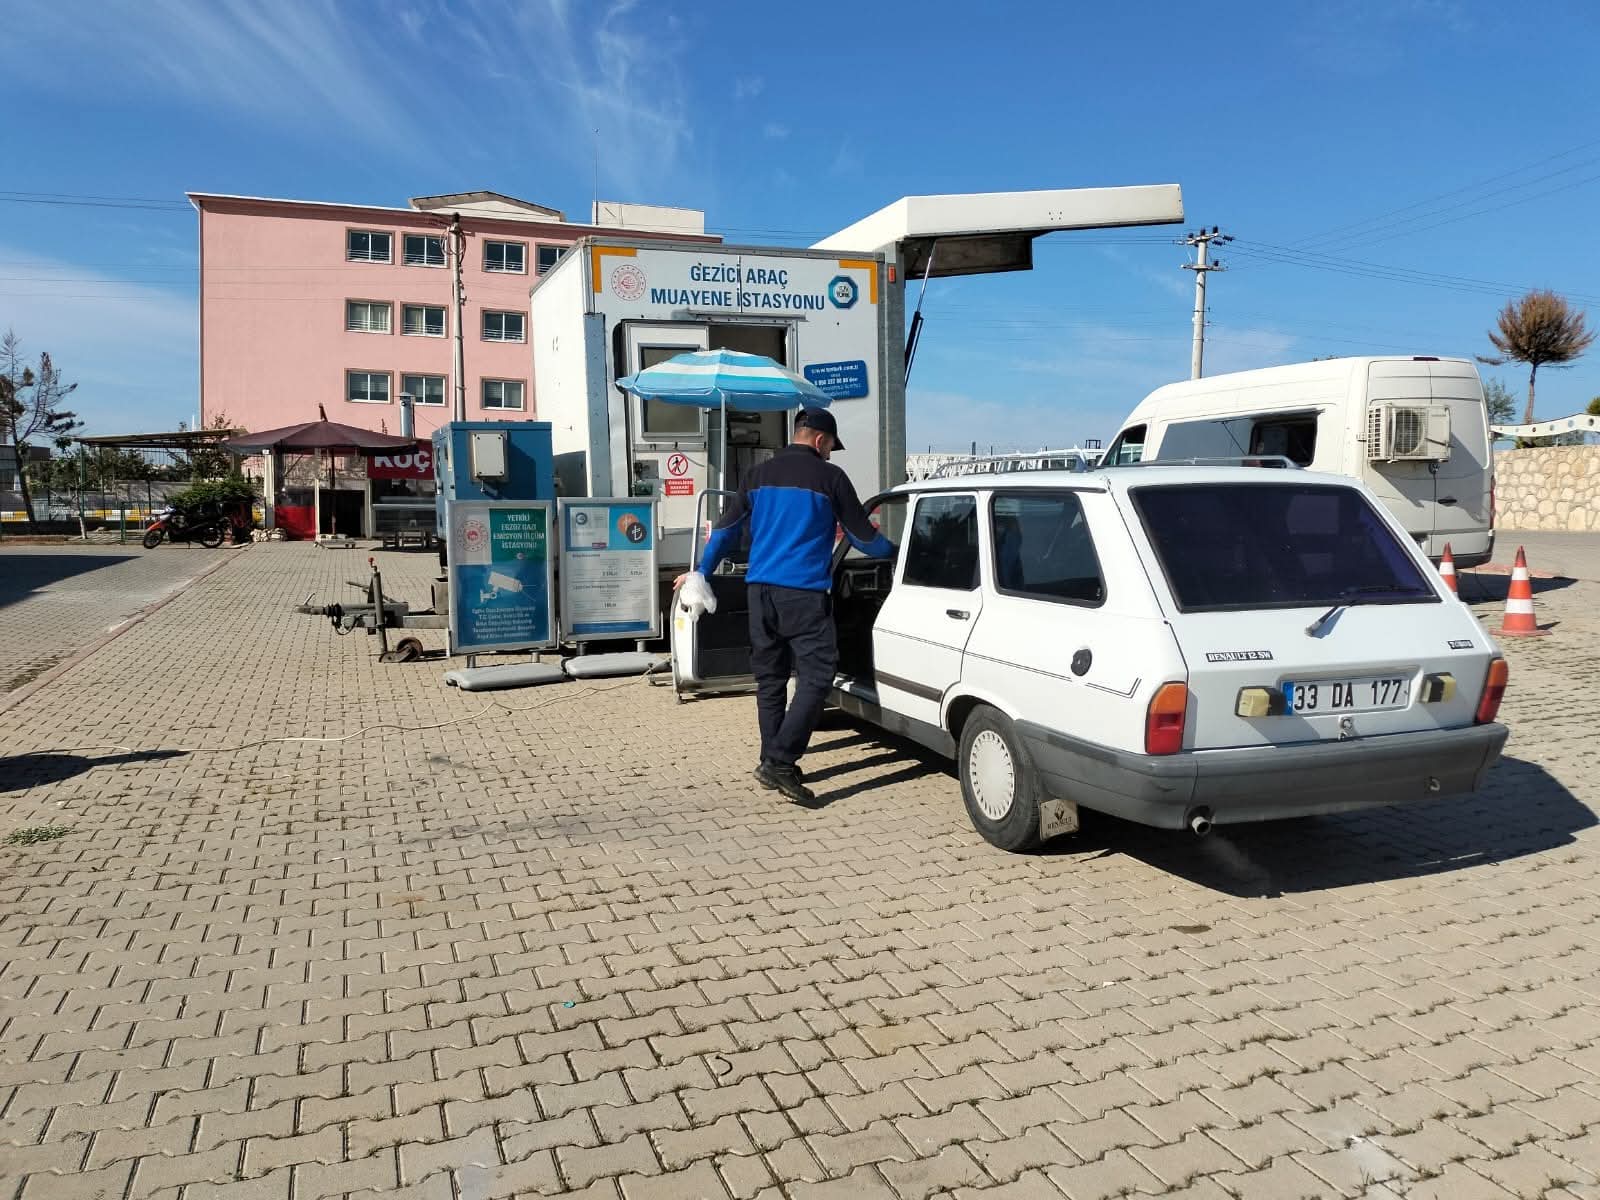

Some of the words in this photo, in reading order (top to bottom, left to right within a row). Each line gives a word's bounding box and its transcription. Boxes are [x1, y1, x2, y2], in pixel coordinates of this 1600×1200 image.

[691, 262, 741, 283] GEZİCİ
[746, 268, 788, 289] ARAÇ
[651, 288, 732, 307] MUAYENE
[736, 288, 825, 310] İSTASYONU
[1207, 652, 1247, 662] RENAULT
[1294, 684, 1318, 710] 33
[1332, 682, 1353, 708] DA
[1371, 679, 1402, 704] 177
